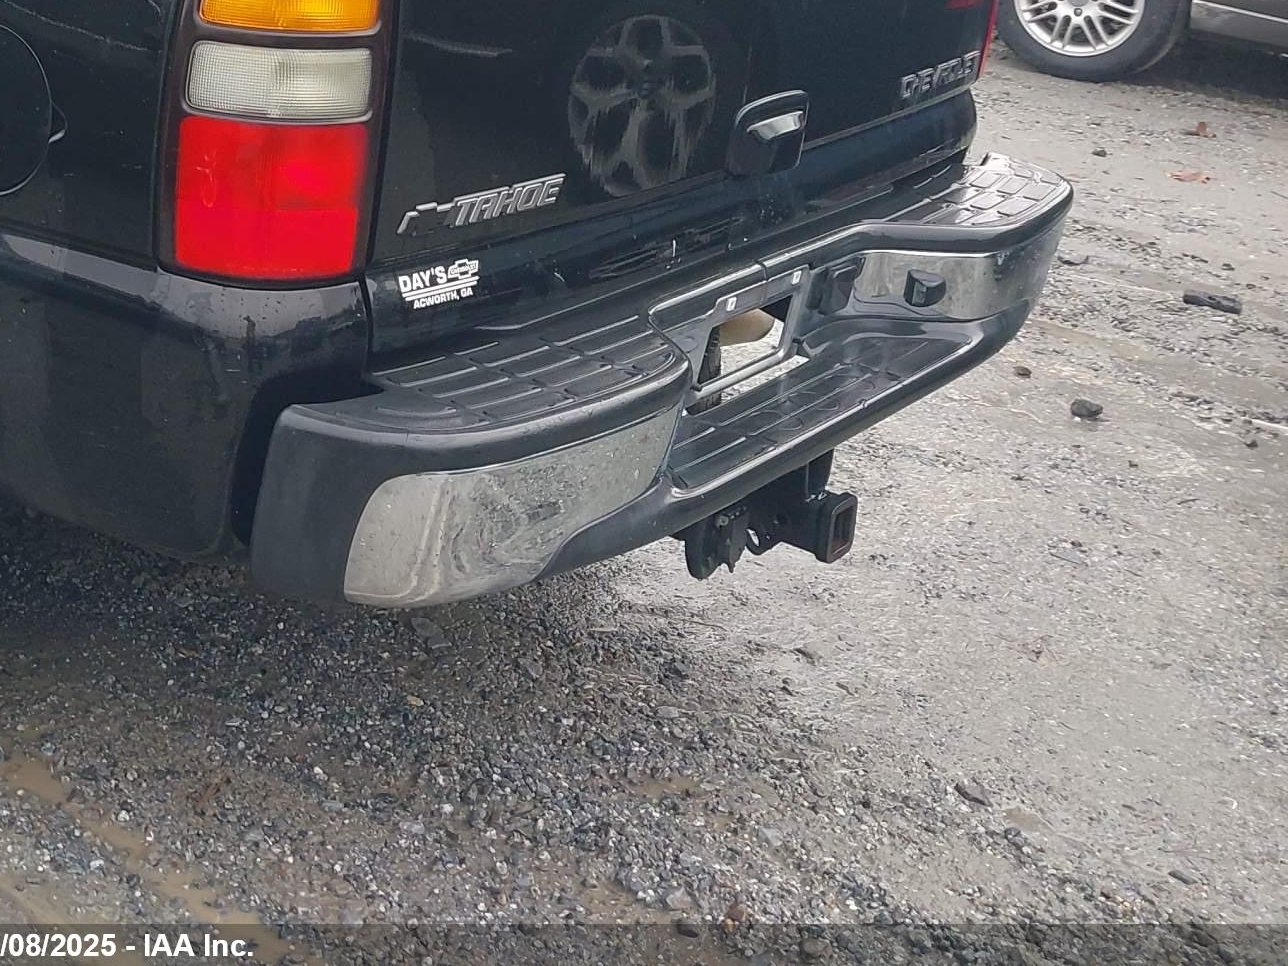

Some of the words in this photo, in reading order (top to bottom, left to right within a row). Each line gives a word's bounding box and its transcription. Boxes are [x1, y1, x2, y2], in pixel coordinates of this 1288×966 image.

[454, 176, 564, 227] TAHOE
[398, 265, 447, 293] DAY'S
[413, 290, 460, 309] ACWORTH,
[460, 287, 474, 298] GA
